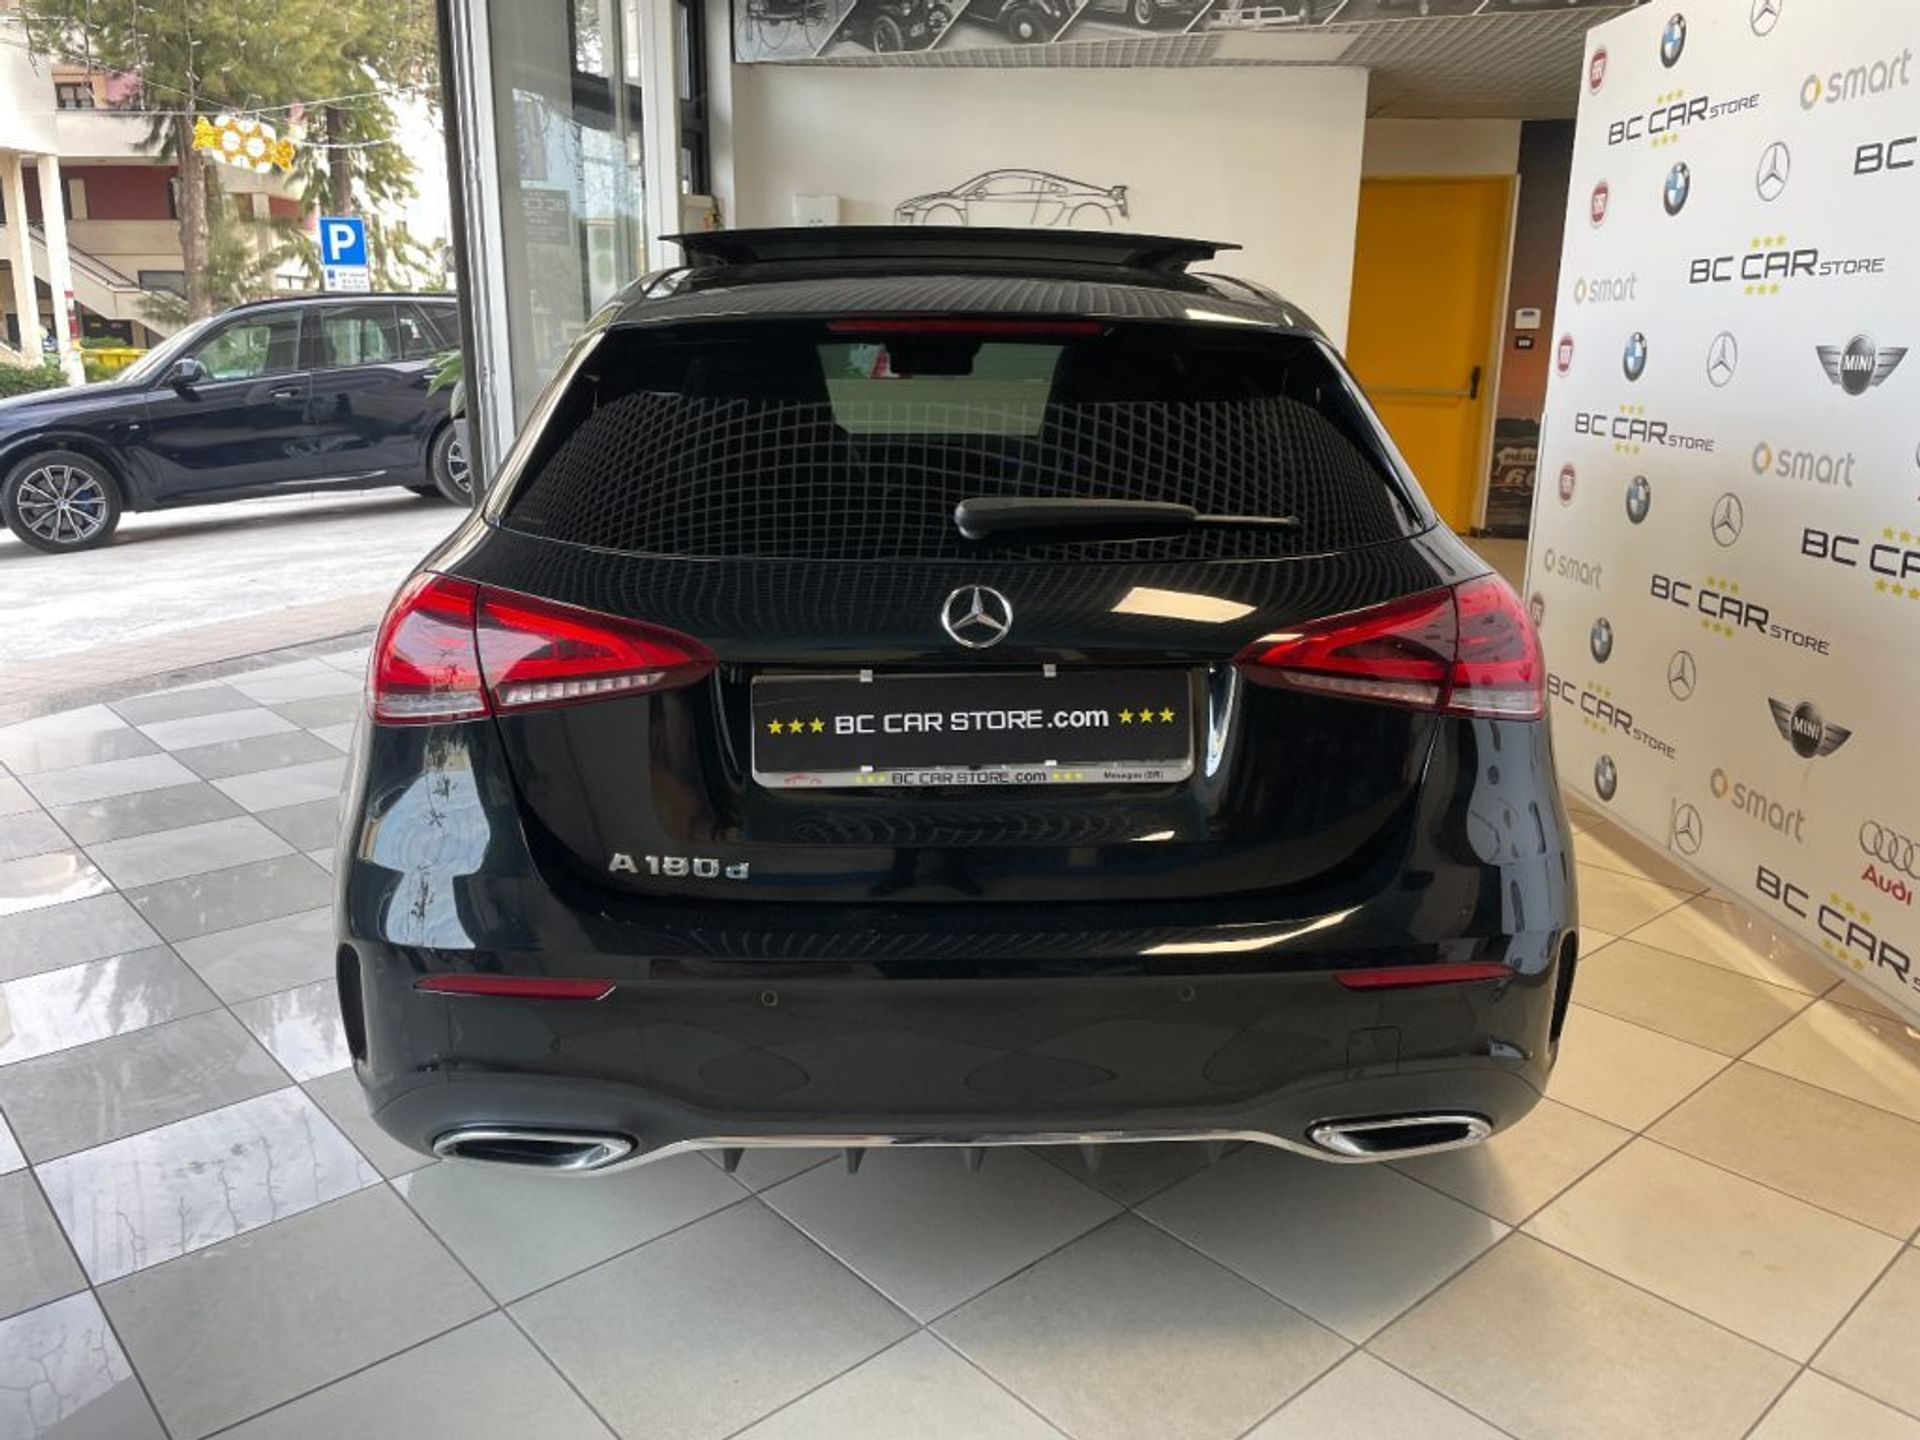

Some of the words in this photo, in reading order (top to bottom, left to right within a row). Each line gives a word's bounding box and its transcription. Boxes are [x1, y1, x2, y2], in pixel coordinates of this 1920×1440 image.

[1826, 48, 1912, 103] smart
[1608, 115, 1643, 145] BC
[1649, 96, 1709, 134] CAR
[1709, 94, 1760, 119] STORE
[1854, 136, 1918, 175] BC
[329, 223, 356, 260] P
[1689, 256, 1733, 284] BC
[1741, 249, 1818, 281] CAR
[1819, 258, 1885, 276] STORE
[1588, 272, 1637, 303] smart
[1843, 354, 1873, 372] MINI
[1575, 413, 1607, 437] BC
[1612, 415, 1668, 445] CAR
[1668, 434, 1715, 452] STORE
[1776, 447, 1855, 488] smart
[1801, 527, 1859, 567] BC
[1557, 551, 1603, 589] smart
[1651, 574, 1692, 607] BC
[1698, 589, 1769, 634] CAR
[1770, 624, 1830, 656] STORE
[835, 714, 875, 734] BC
[883, 712, 943, 733] CAR
[1547, 673, 1576, 705] BC
[1580, 691, 1632, 735] CAR
[1632, 727, 1676, 760] STORE
[1793, 716, 1820, 740] MINI
[892, 771, 915, 785] BC
[919, 771, 953, 785] CAR
[1731, 783, 1805, 843] smart
[608, 852, 639, 873] A
[645, 855, 720, 878] 180
[725, 862, 750, 879] d
[1861, 864, 1912, 905] Audi
[1756, 864, 1809, 919] BC
[1817, 904, 1911, 984] CAR
